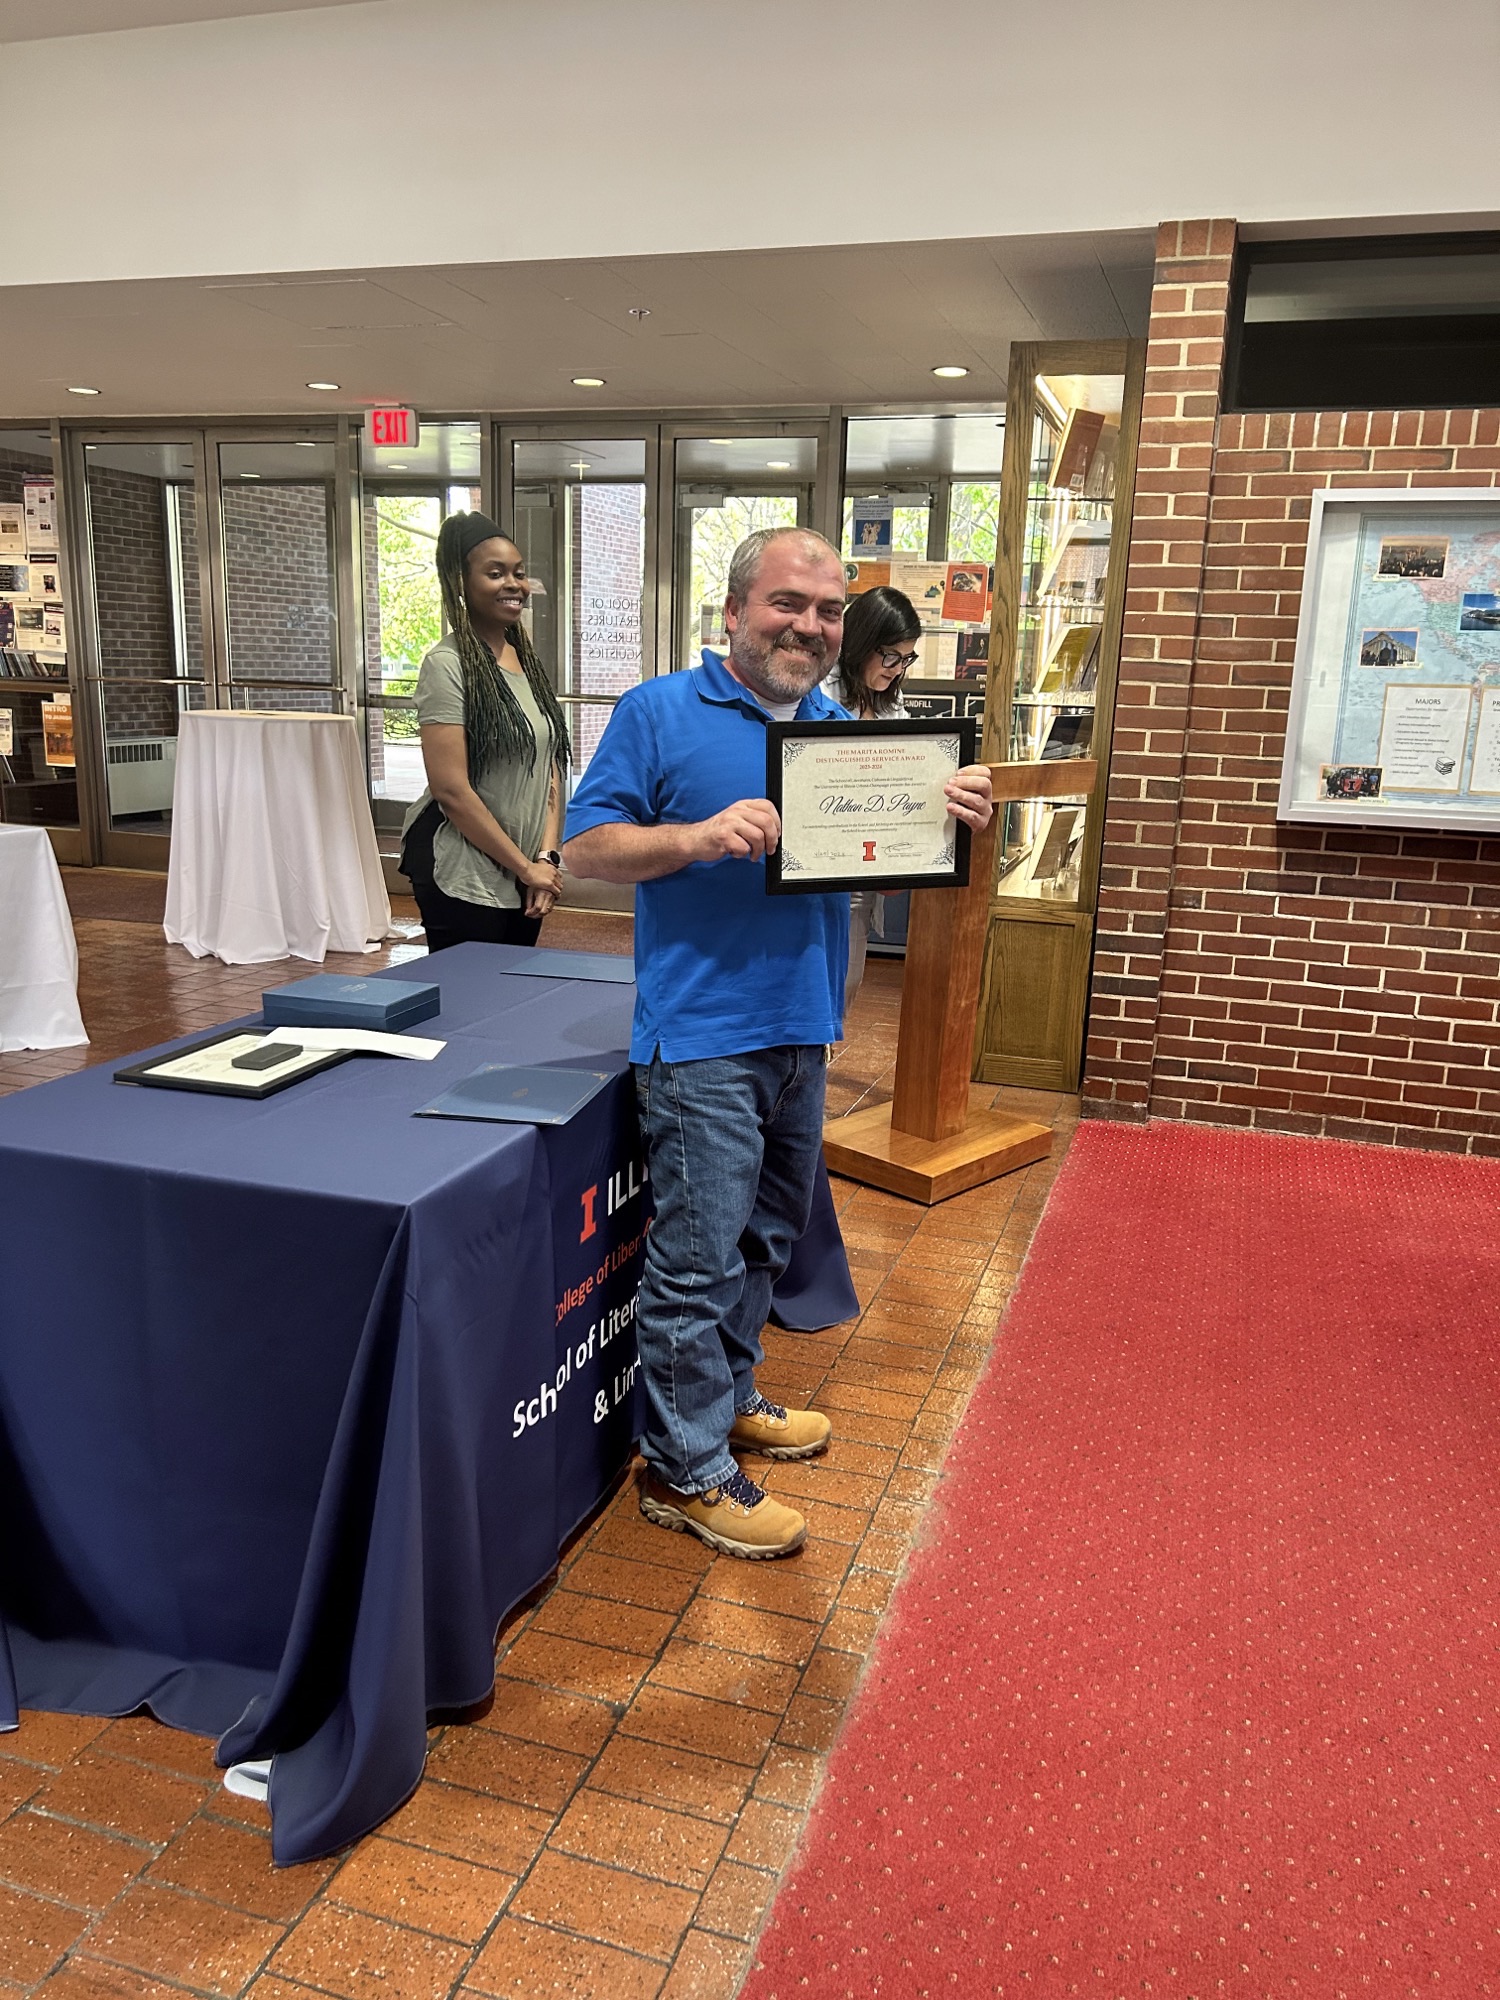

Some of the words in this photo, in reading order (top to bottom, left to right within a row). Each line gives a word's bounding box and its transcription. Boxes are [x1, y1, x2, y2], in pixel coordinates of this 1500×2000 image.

[372, 411, 408, 444] EXIT
[903, 700, 932, 709] ANDFILL
[815, 756, 871, 764] DISTINGUISHED
[871, 755, 900, 763] SERVICE
[819, 795, 863, 816] Nathan
[863, 793, 885, 813] D.
[886, 793, 927, 817] Payne
[596, 1255, 610, 1285] of
[611, 1235, 641, 1272] Liber
[575, 1324, 596, 1370] of
[593, 1388, 609, 1424] &
